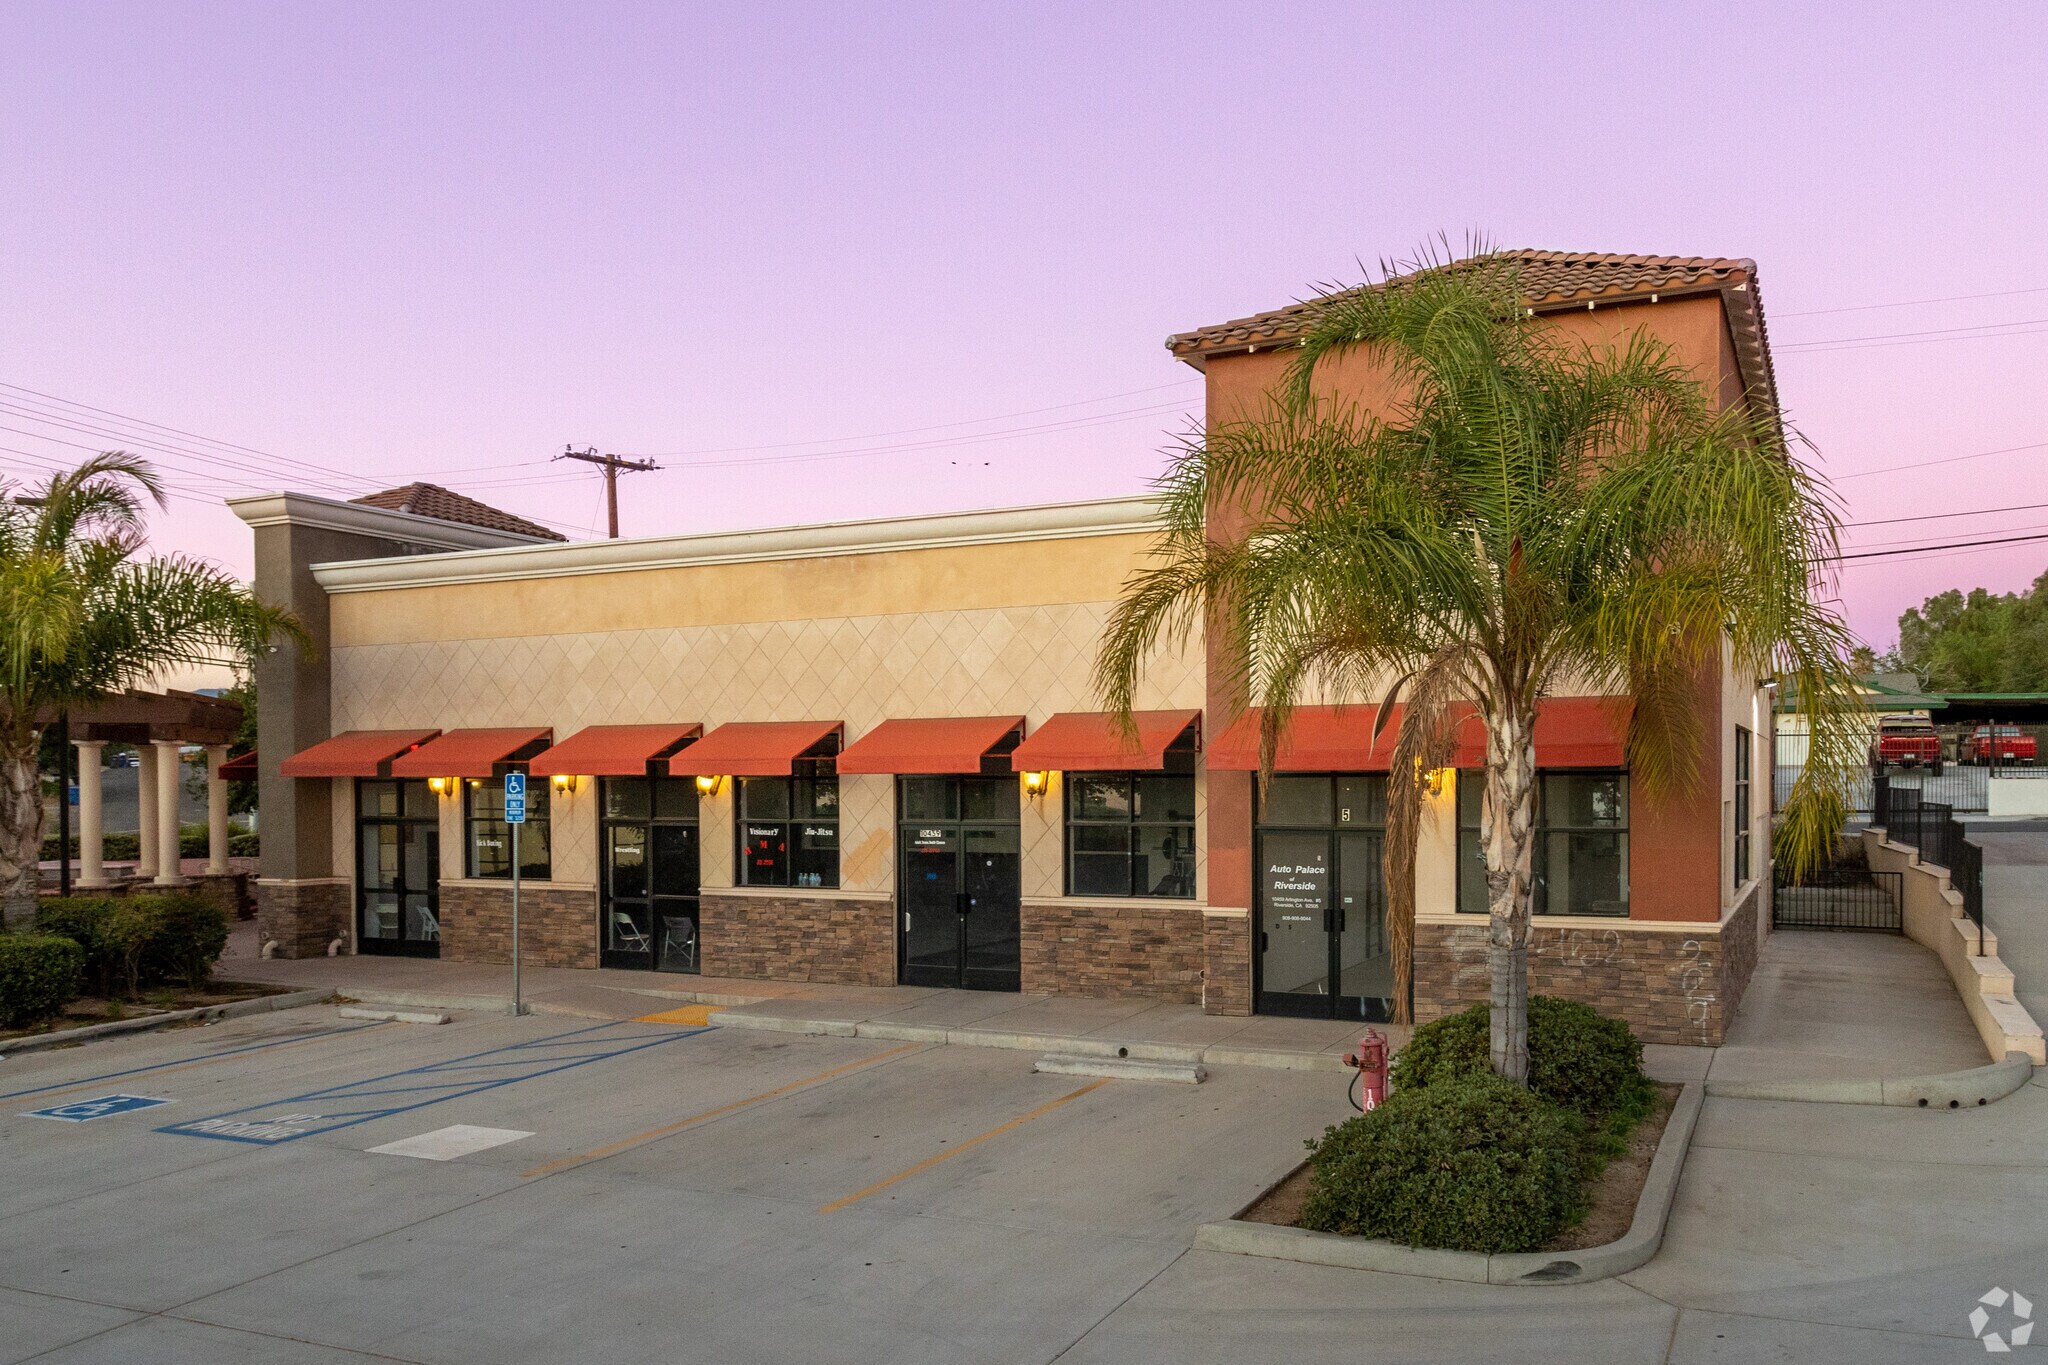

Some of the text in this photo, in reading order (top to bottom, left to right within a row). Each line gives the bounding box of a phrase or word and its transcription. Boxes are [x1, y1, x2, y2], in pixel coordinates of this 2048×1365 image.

[1343, 809, 1348, 820] 5
[804, 827, 833, 836] Jiu-Jitsu
[1270, 865, 1325, 874] Auto Palace
[1274, 881, 1316, 890] Riverside
